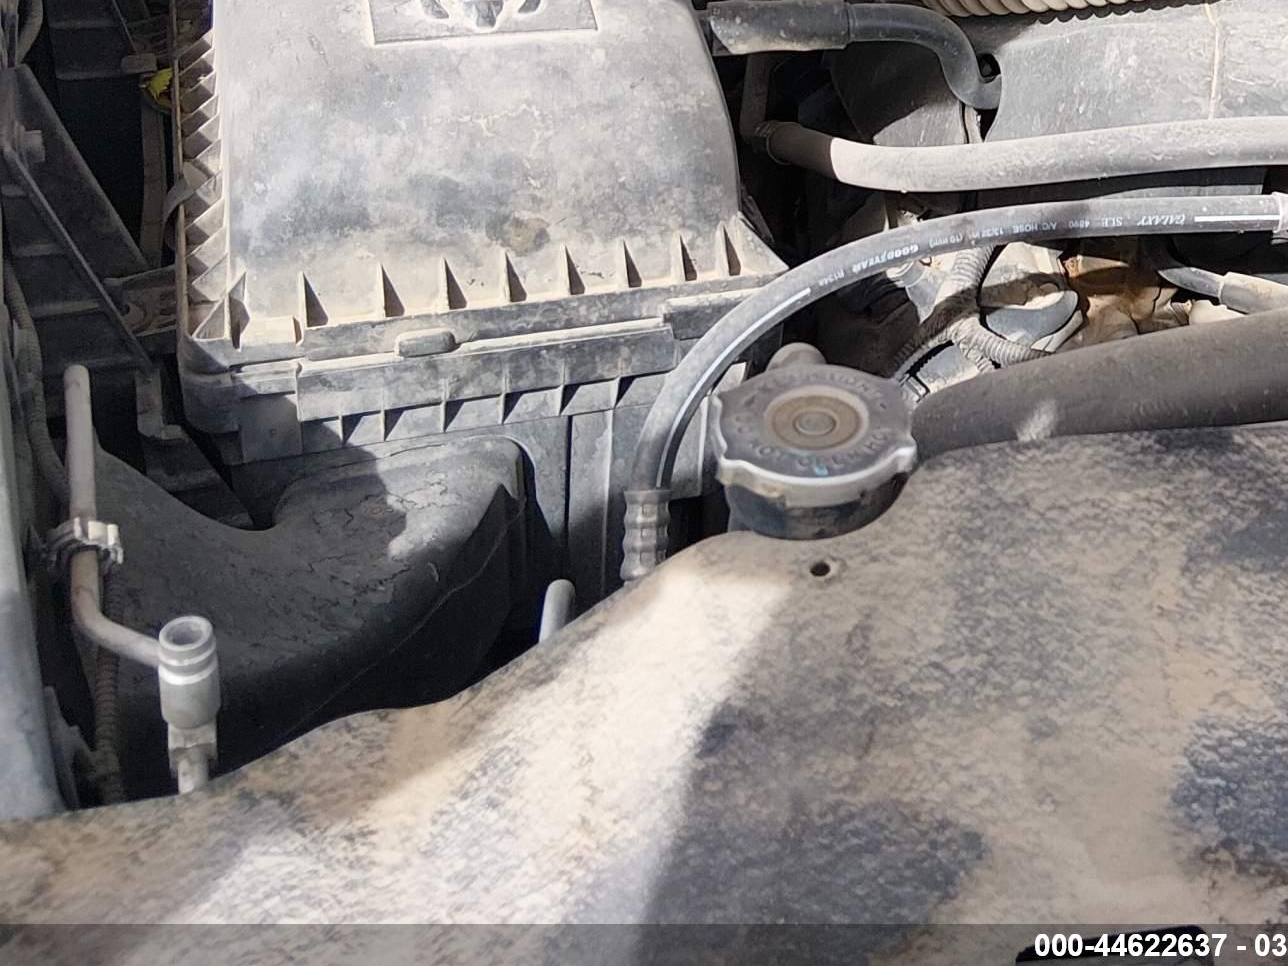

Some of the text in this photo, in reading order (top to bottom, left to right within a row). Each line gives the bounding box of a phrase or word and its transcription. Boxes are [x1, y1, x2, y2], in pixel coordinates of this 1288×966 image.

[1137, 214, 1185, 227] GALAXY
[1012, 223, 1039, 235] HOSE
[851, 244, 920, 274] GOODYEAR
